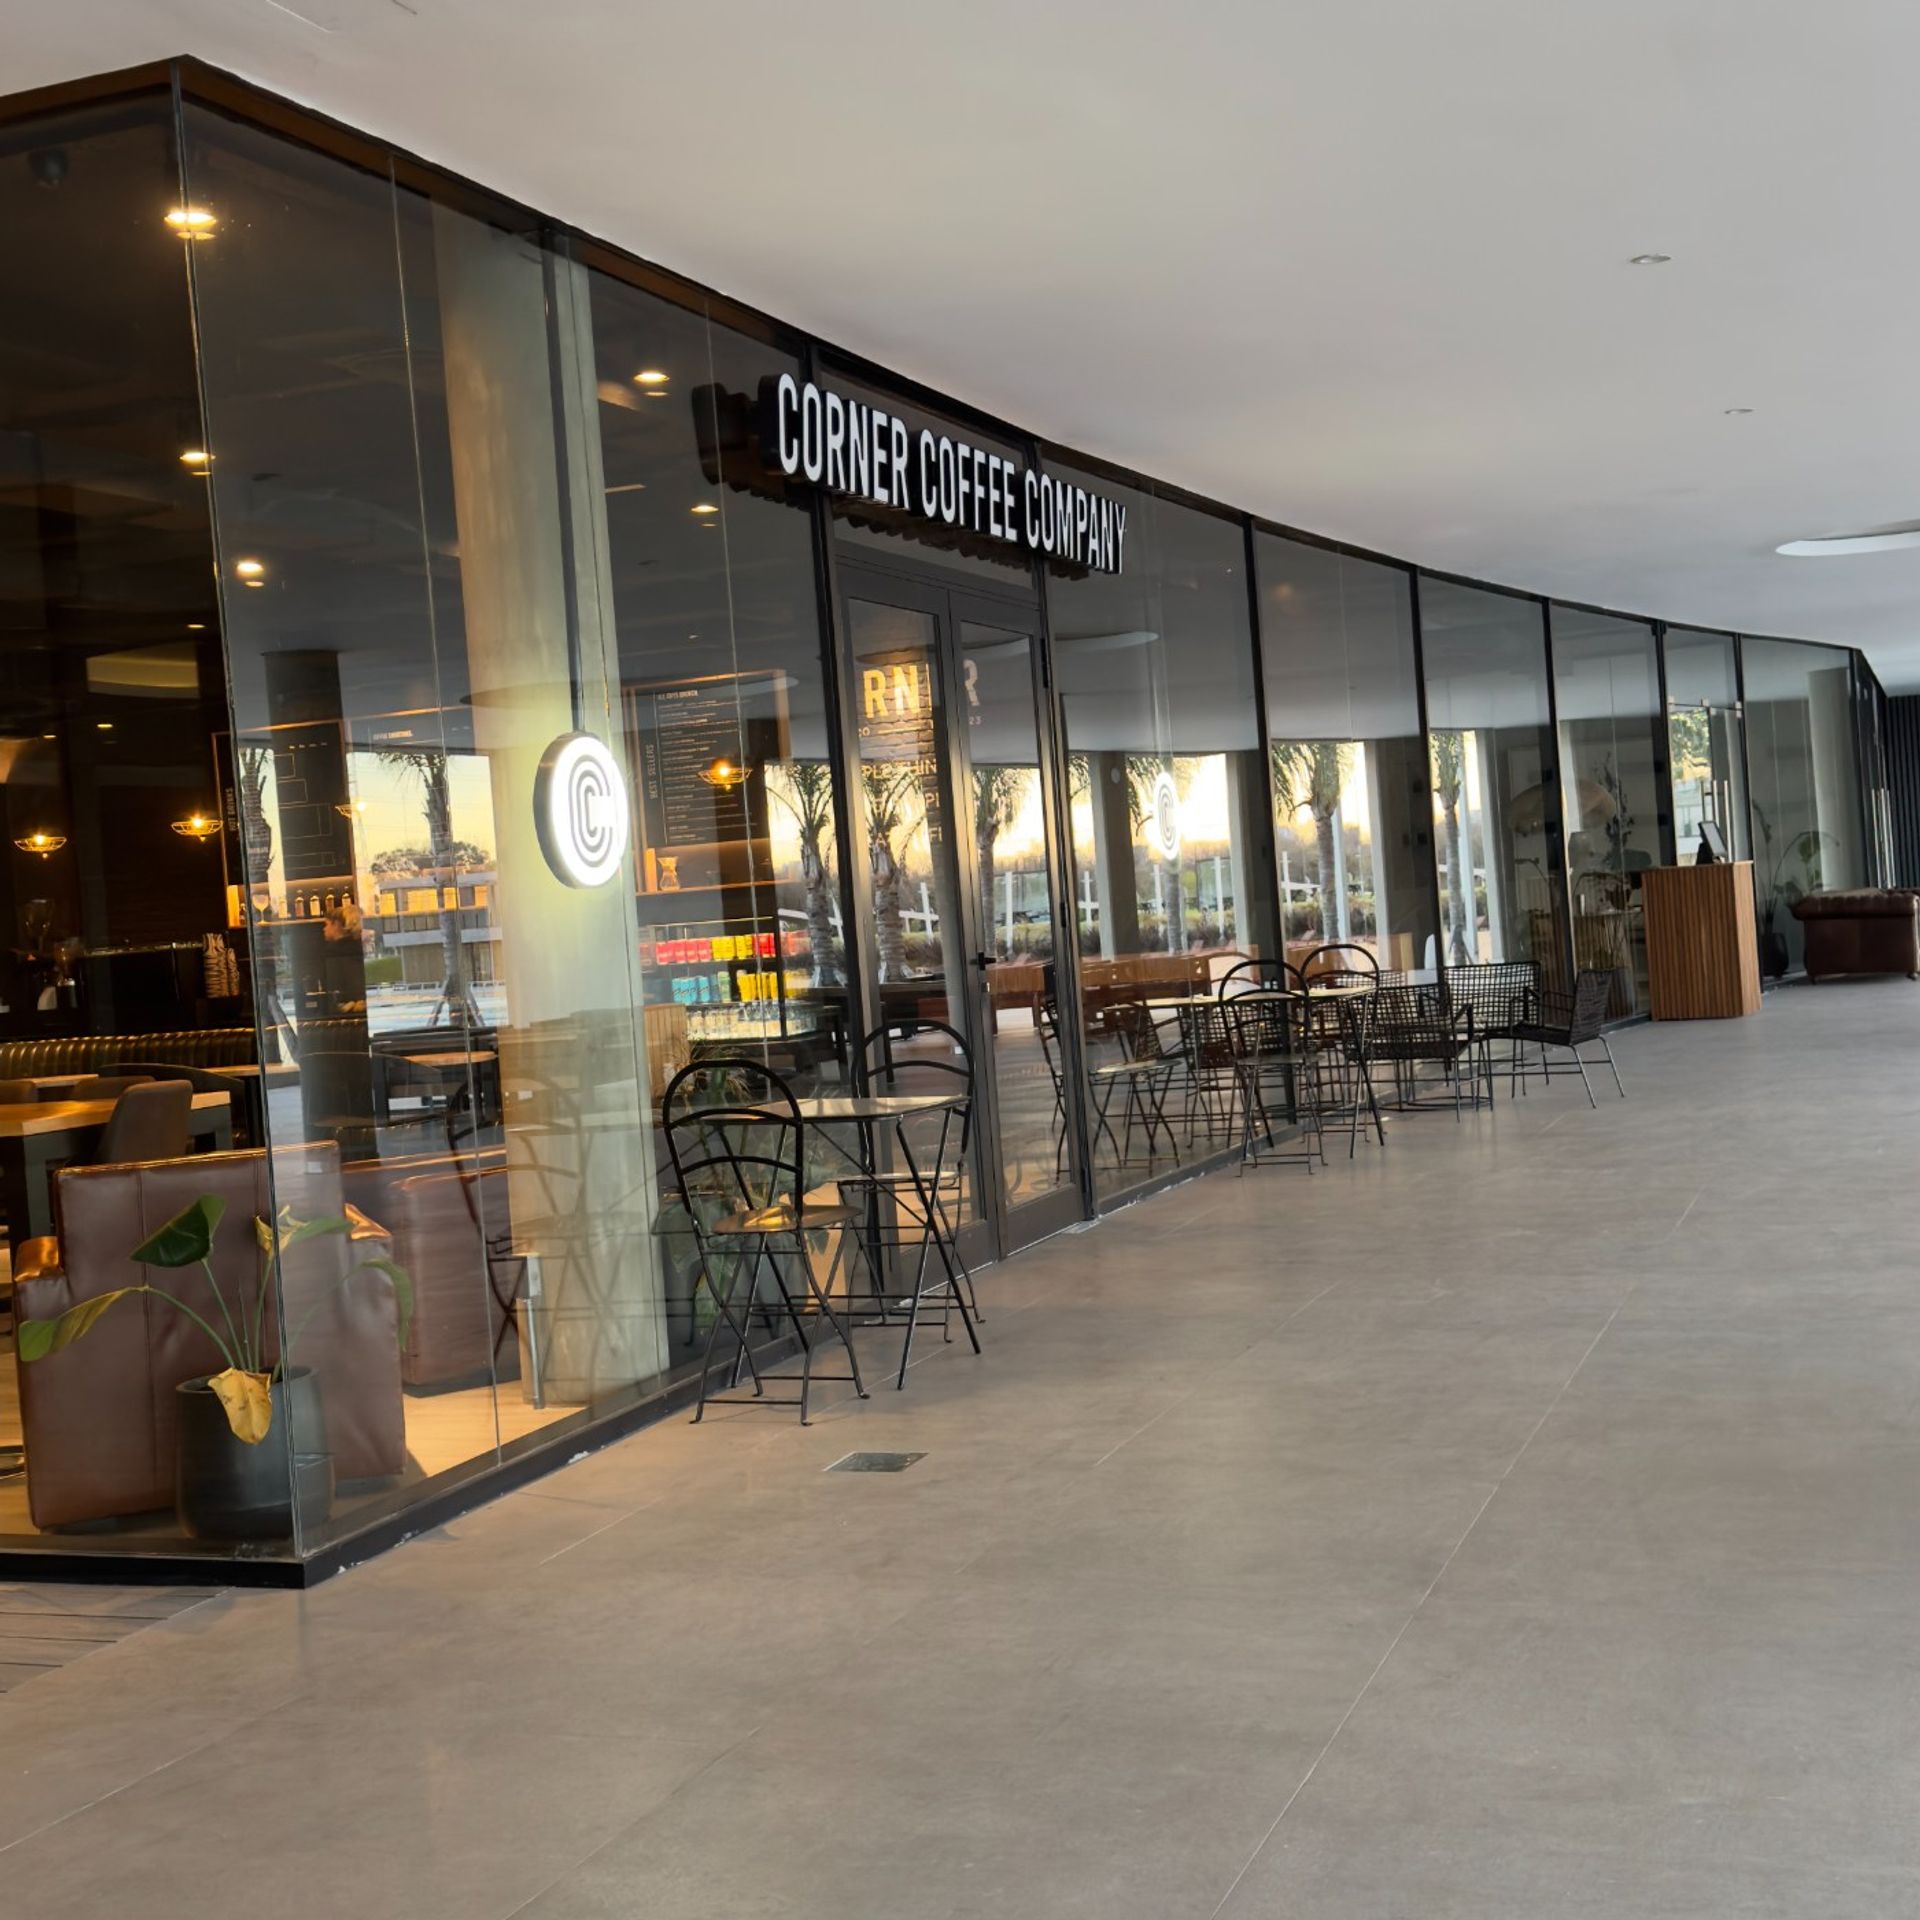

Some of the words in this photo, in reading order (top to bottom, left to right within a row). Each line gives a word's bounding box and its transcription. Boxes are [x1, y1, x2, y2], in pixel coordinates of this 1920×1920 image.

[778, 372, 910, 510] CORNER
[920, 428, 1018, 542] COFFEE
[1024, 468, 1127, 575] COMPANY
